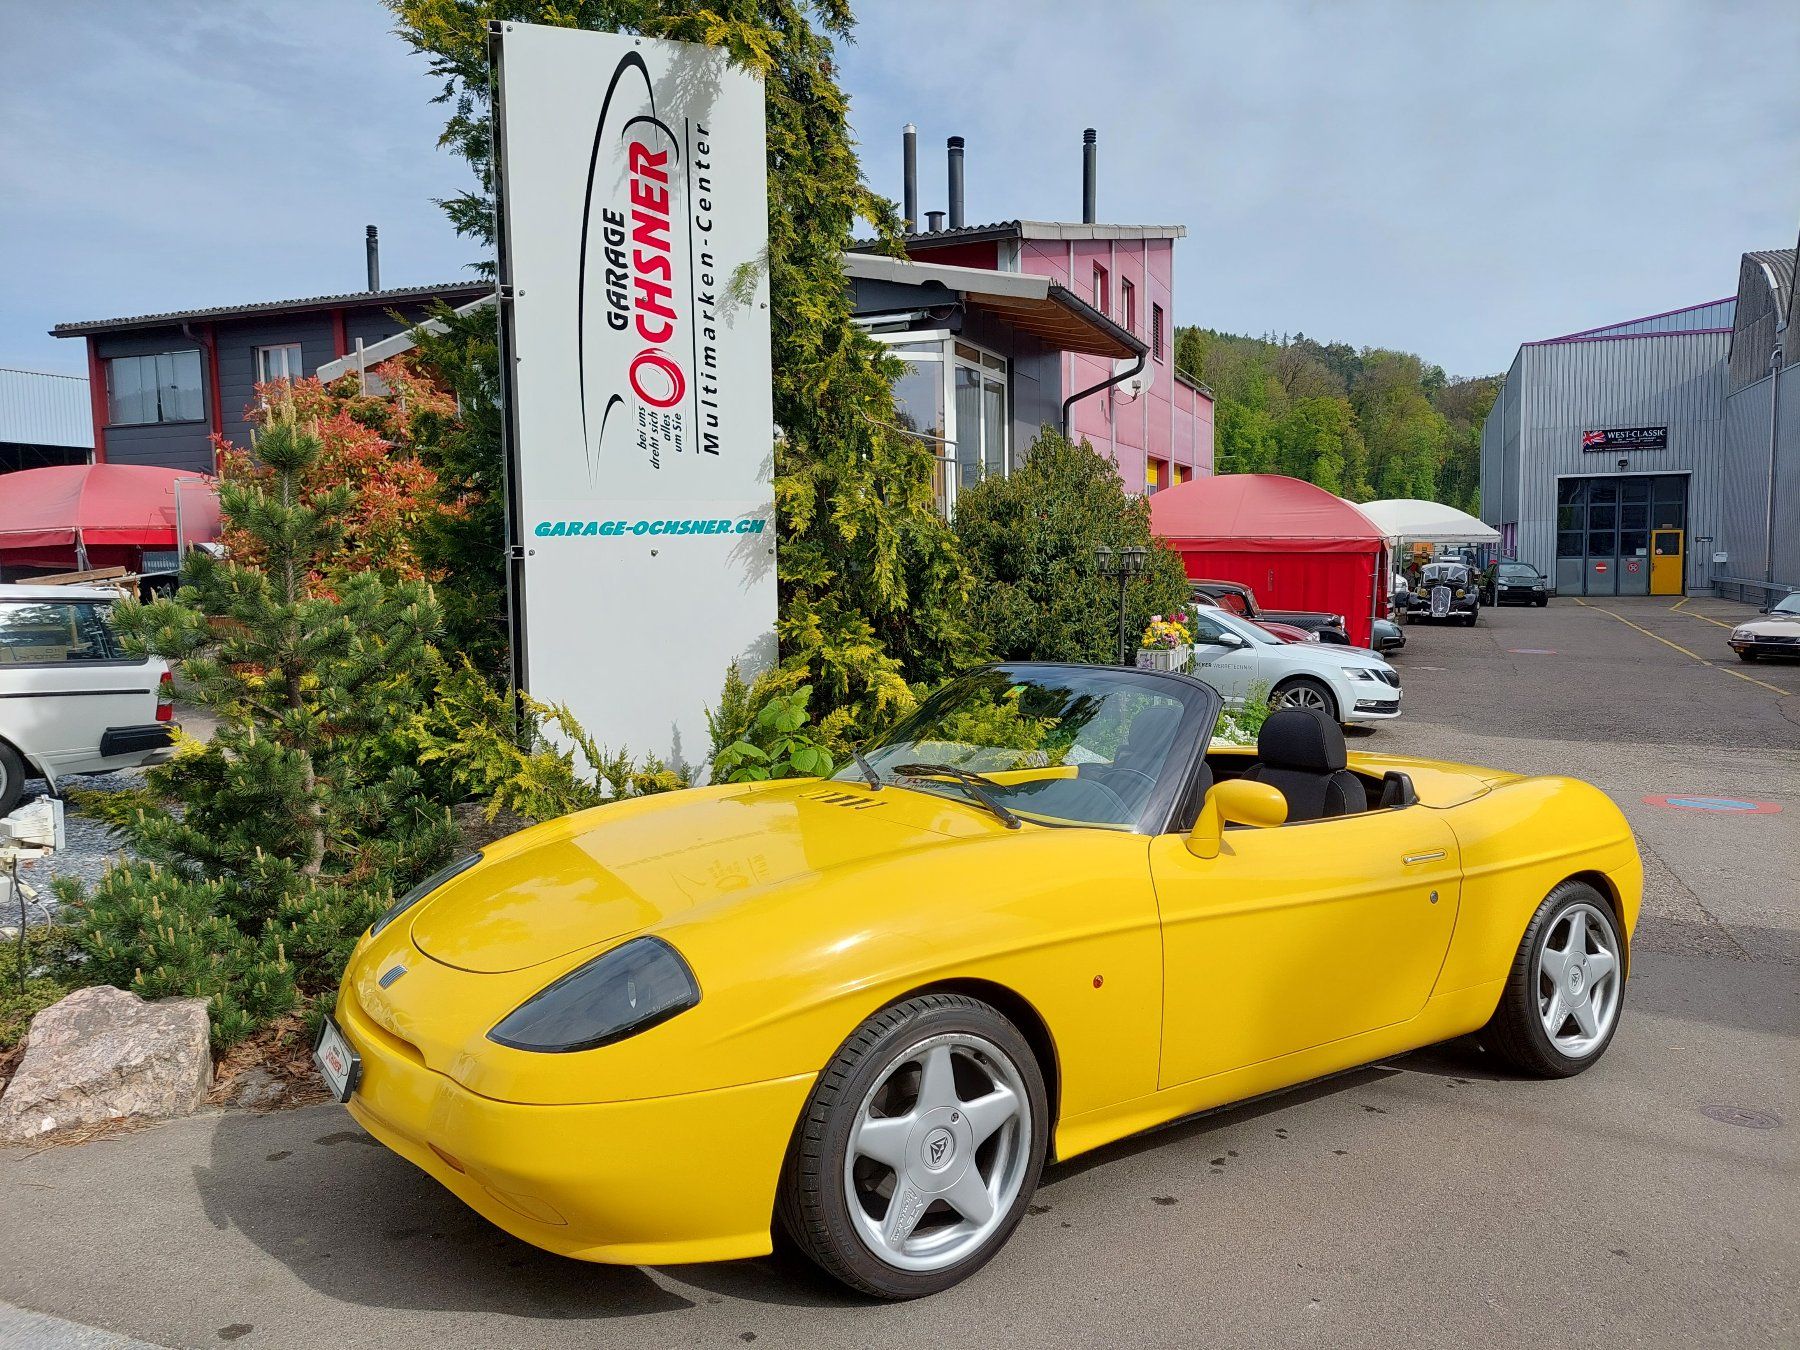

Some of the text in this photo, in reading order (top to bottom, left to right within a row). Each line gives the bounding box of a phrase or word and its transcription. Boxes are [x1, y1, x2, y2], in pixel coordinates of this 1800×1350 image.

[602, 207, 631, 331] GARAGE
[696, 122, 720, 456] Multimarken-Center
[636, 406, 647, 450] bei uns
[647, 411, 660, 469] dreht sich
[660, 413, 671, 441] alles
[671, 413, 682, 452] um Sie
[1607, 429, 1666, 439] WEST-CLASSIC
[533, 518, 766, 538] GARAGE-OCHSNER.CH
